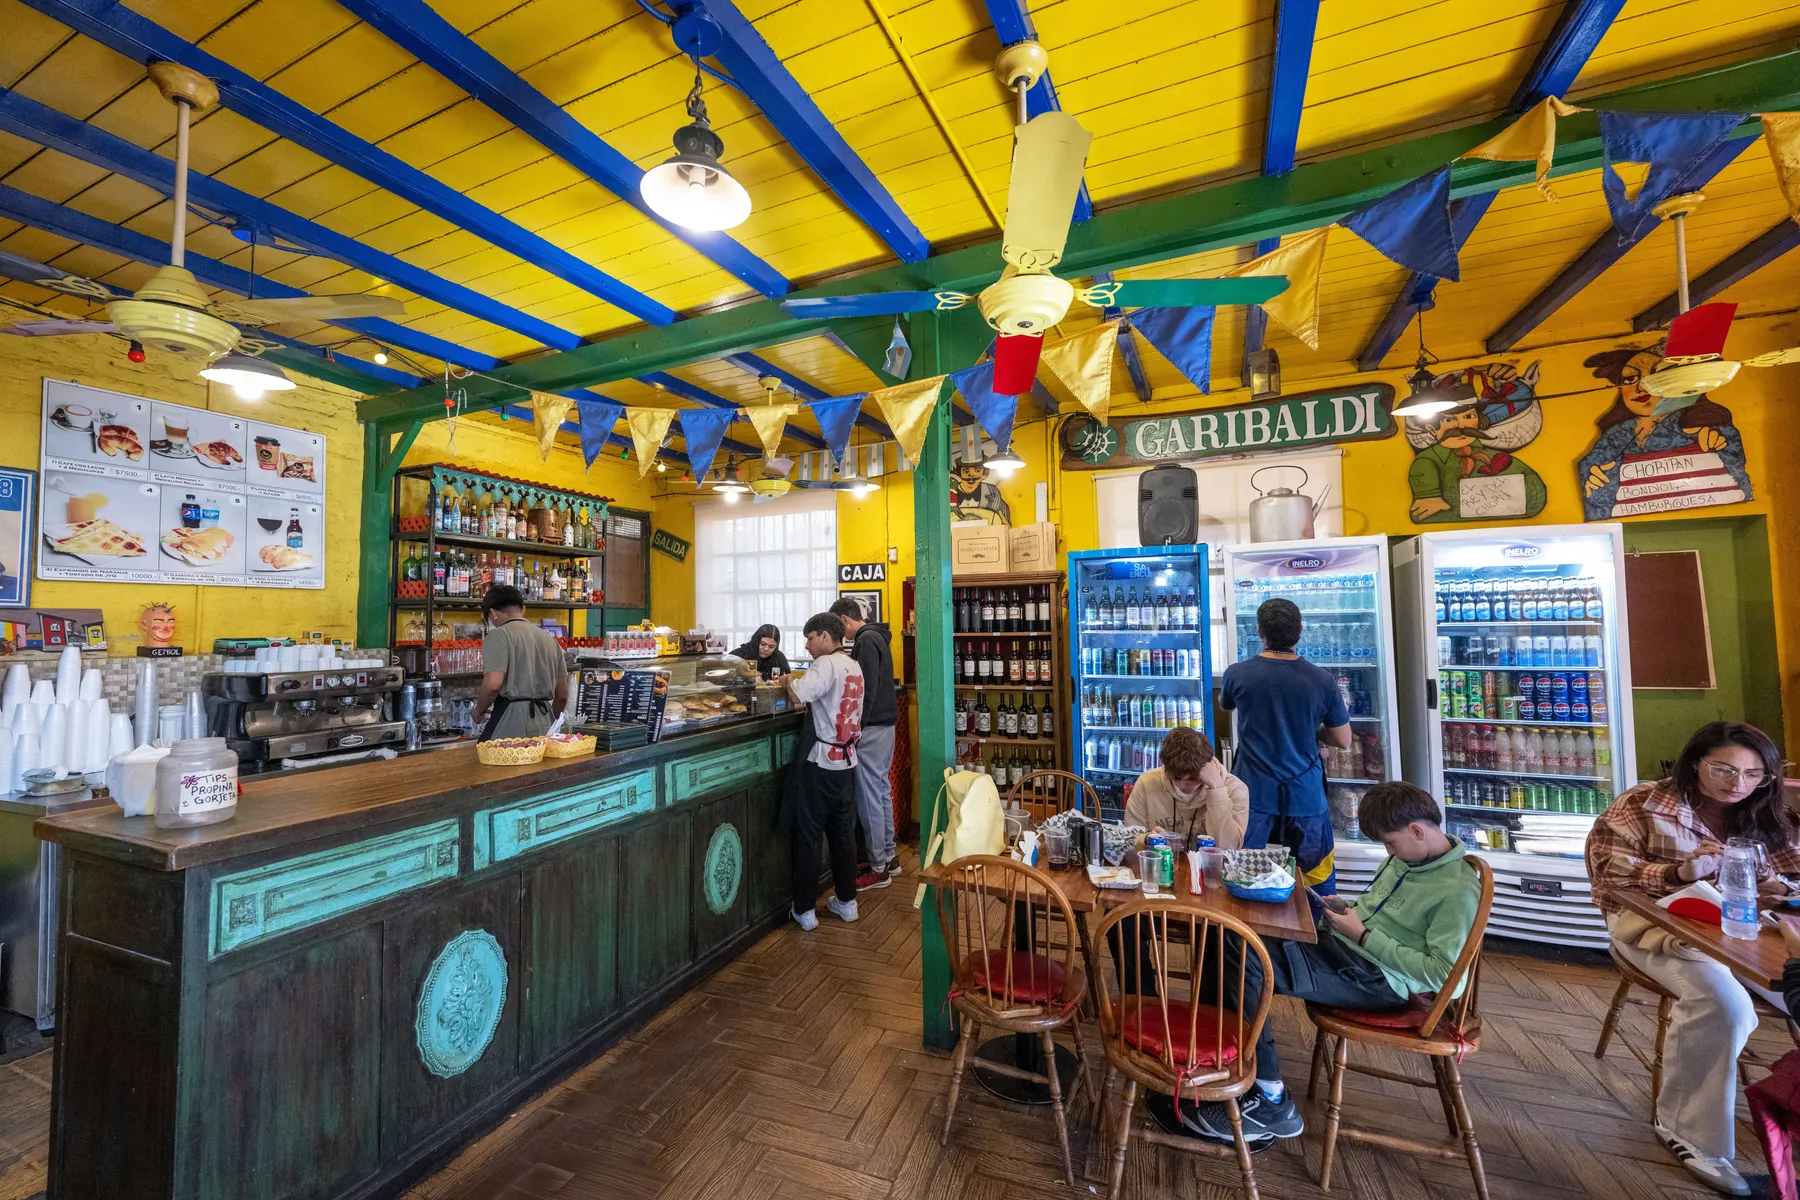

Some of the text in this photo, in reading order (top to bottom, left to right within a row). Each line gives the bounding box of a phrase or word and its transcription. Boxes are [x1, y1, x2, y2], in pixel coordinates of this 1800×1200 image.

[1135, 392, 1381, 458] GARIBALDI
[68, 466, 105, 474] MEDIALUNAS
[155, 477, 182, 485] MEDIALUNA
[0, 478, 13, 498] 8
[1461, 484, 1477, 496] EL
[1462, 477, 1508, 508] REY DEL
[1620, 495, 1716, 515] HAMBURGUESA
[654, 533, 686, 557] SALIDA
[1505, 547, 1539, 557] INELRO
[1291, 559, 1320, 568] INELRO
[841, 564, 885, 581] CAJA
[152, 648, 181, 657] GENIOL
[191, 782, 233, 796] PROPINA
[194, 793, 236, 805] GORJETA
